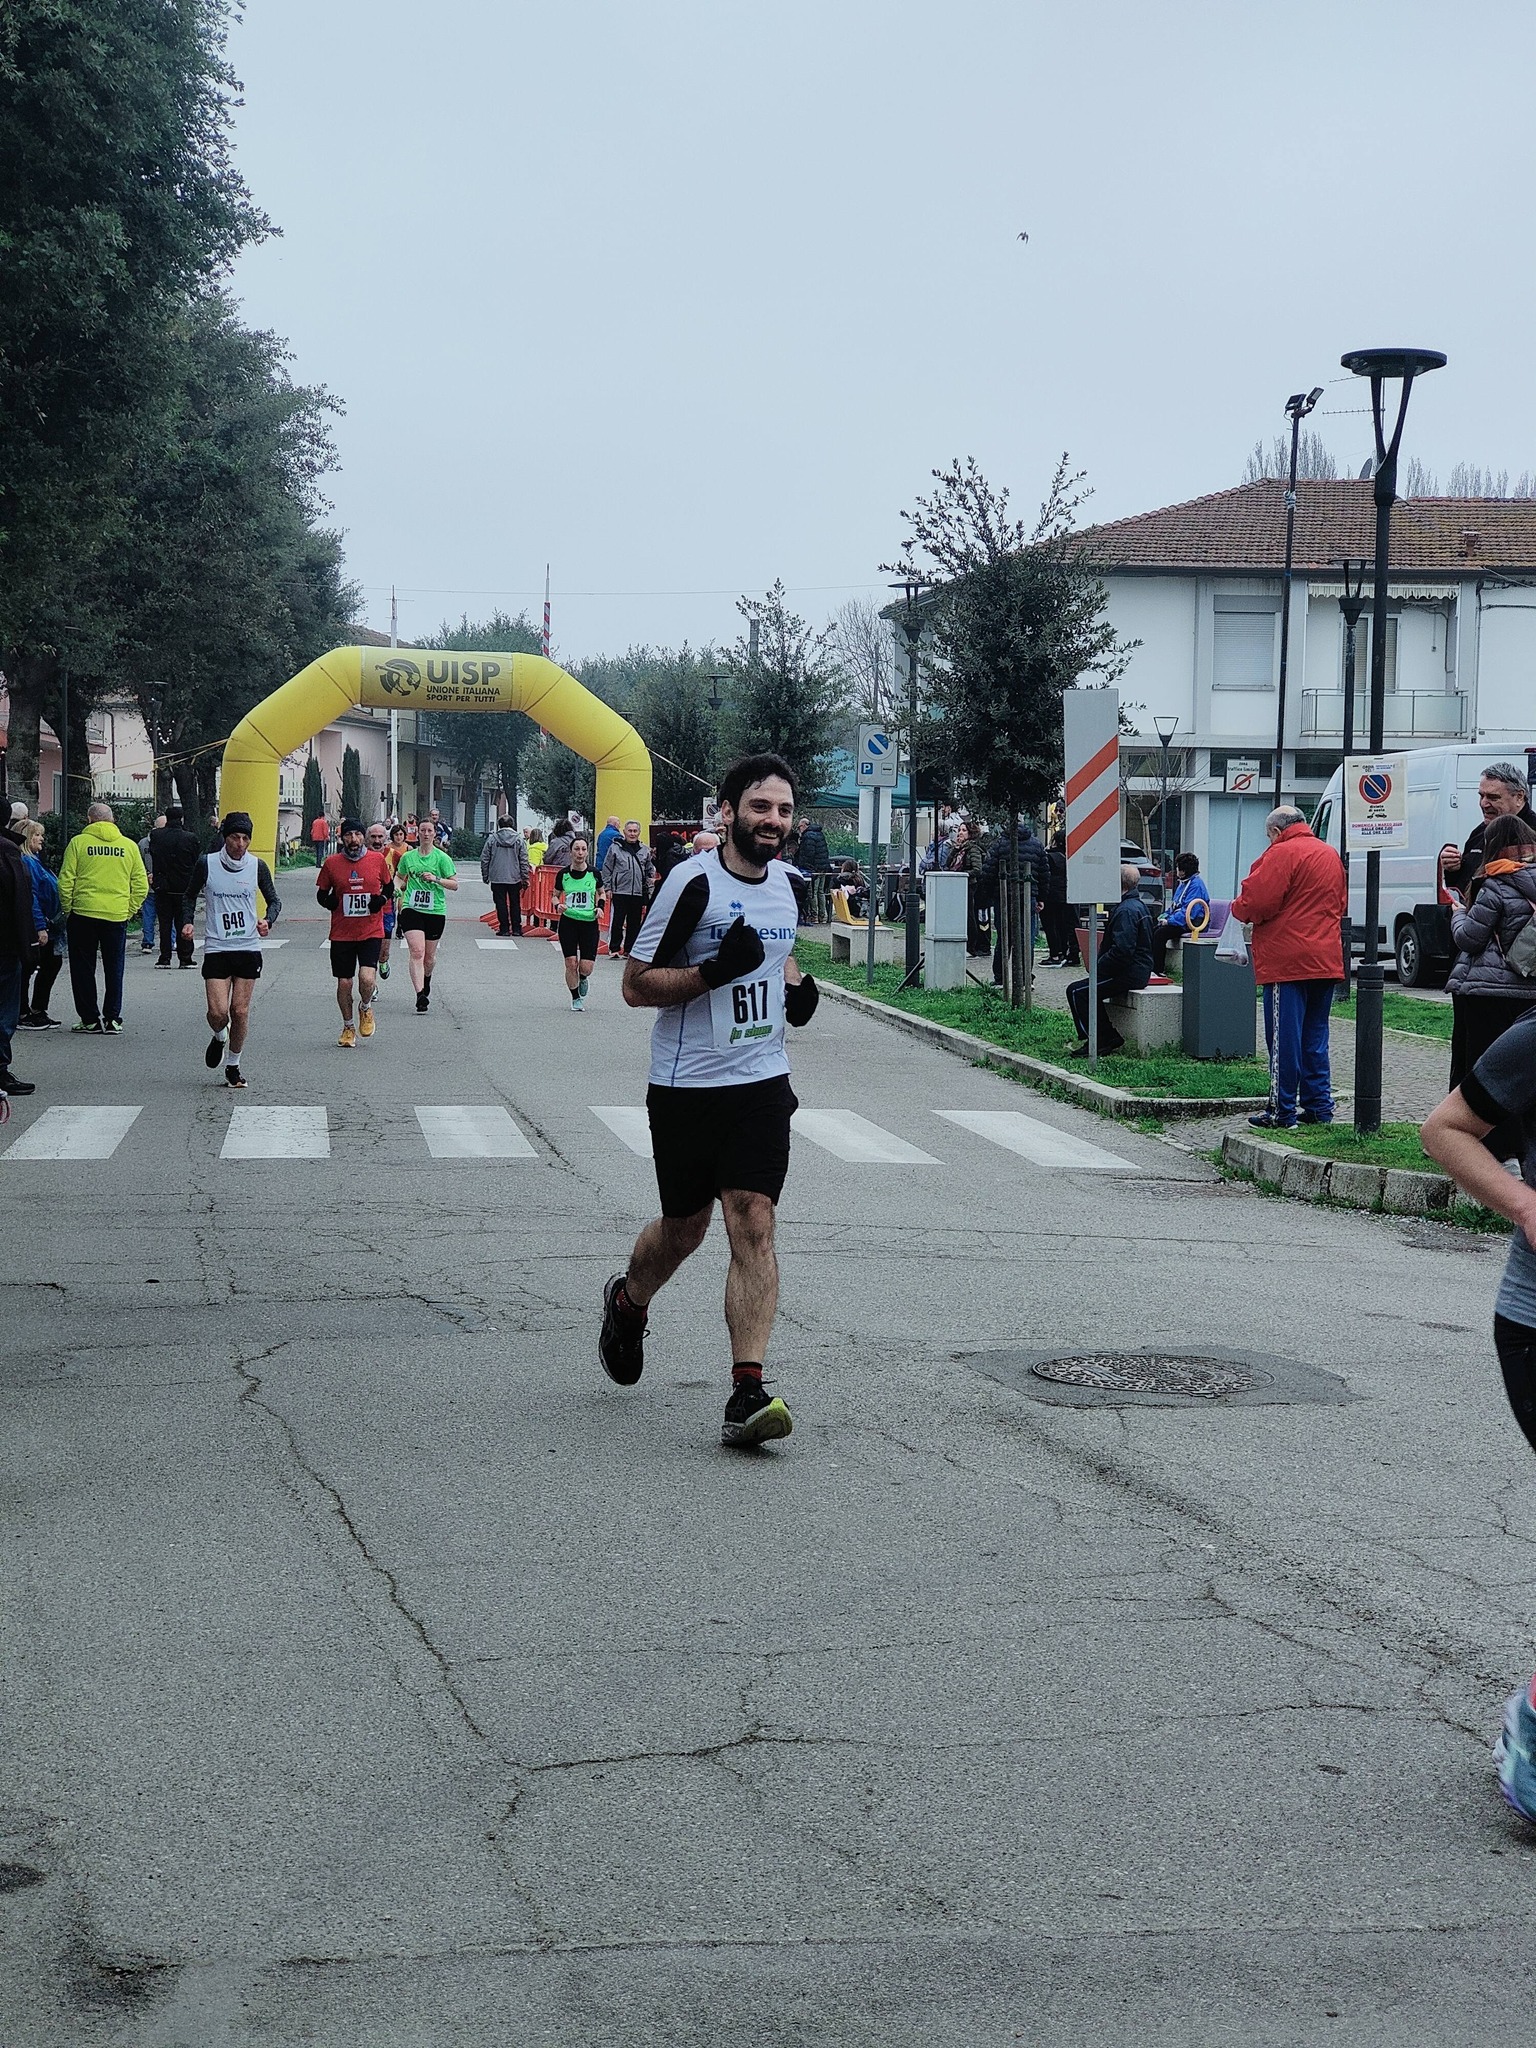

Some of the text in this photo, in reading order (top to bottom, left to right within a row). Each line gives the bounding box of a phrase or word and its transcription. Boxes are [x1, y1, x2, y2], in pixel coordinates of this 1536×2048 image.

[427, 660, 500, 685] UISP
[427, 685, 501, 695] UNIONE ITALIANA
[87, 846, 125, 857] GIUDICE
[348, 894, 367, 909] 756
[414, 890, 431, 903] 636
[571, 892, 587, 904] 738
[222, 911, 246, 930] 648
[732, 980, 768, 1024] 617
